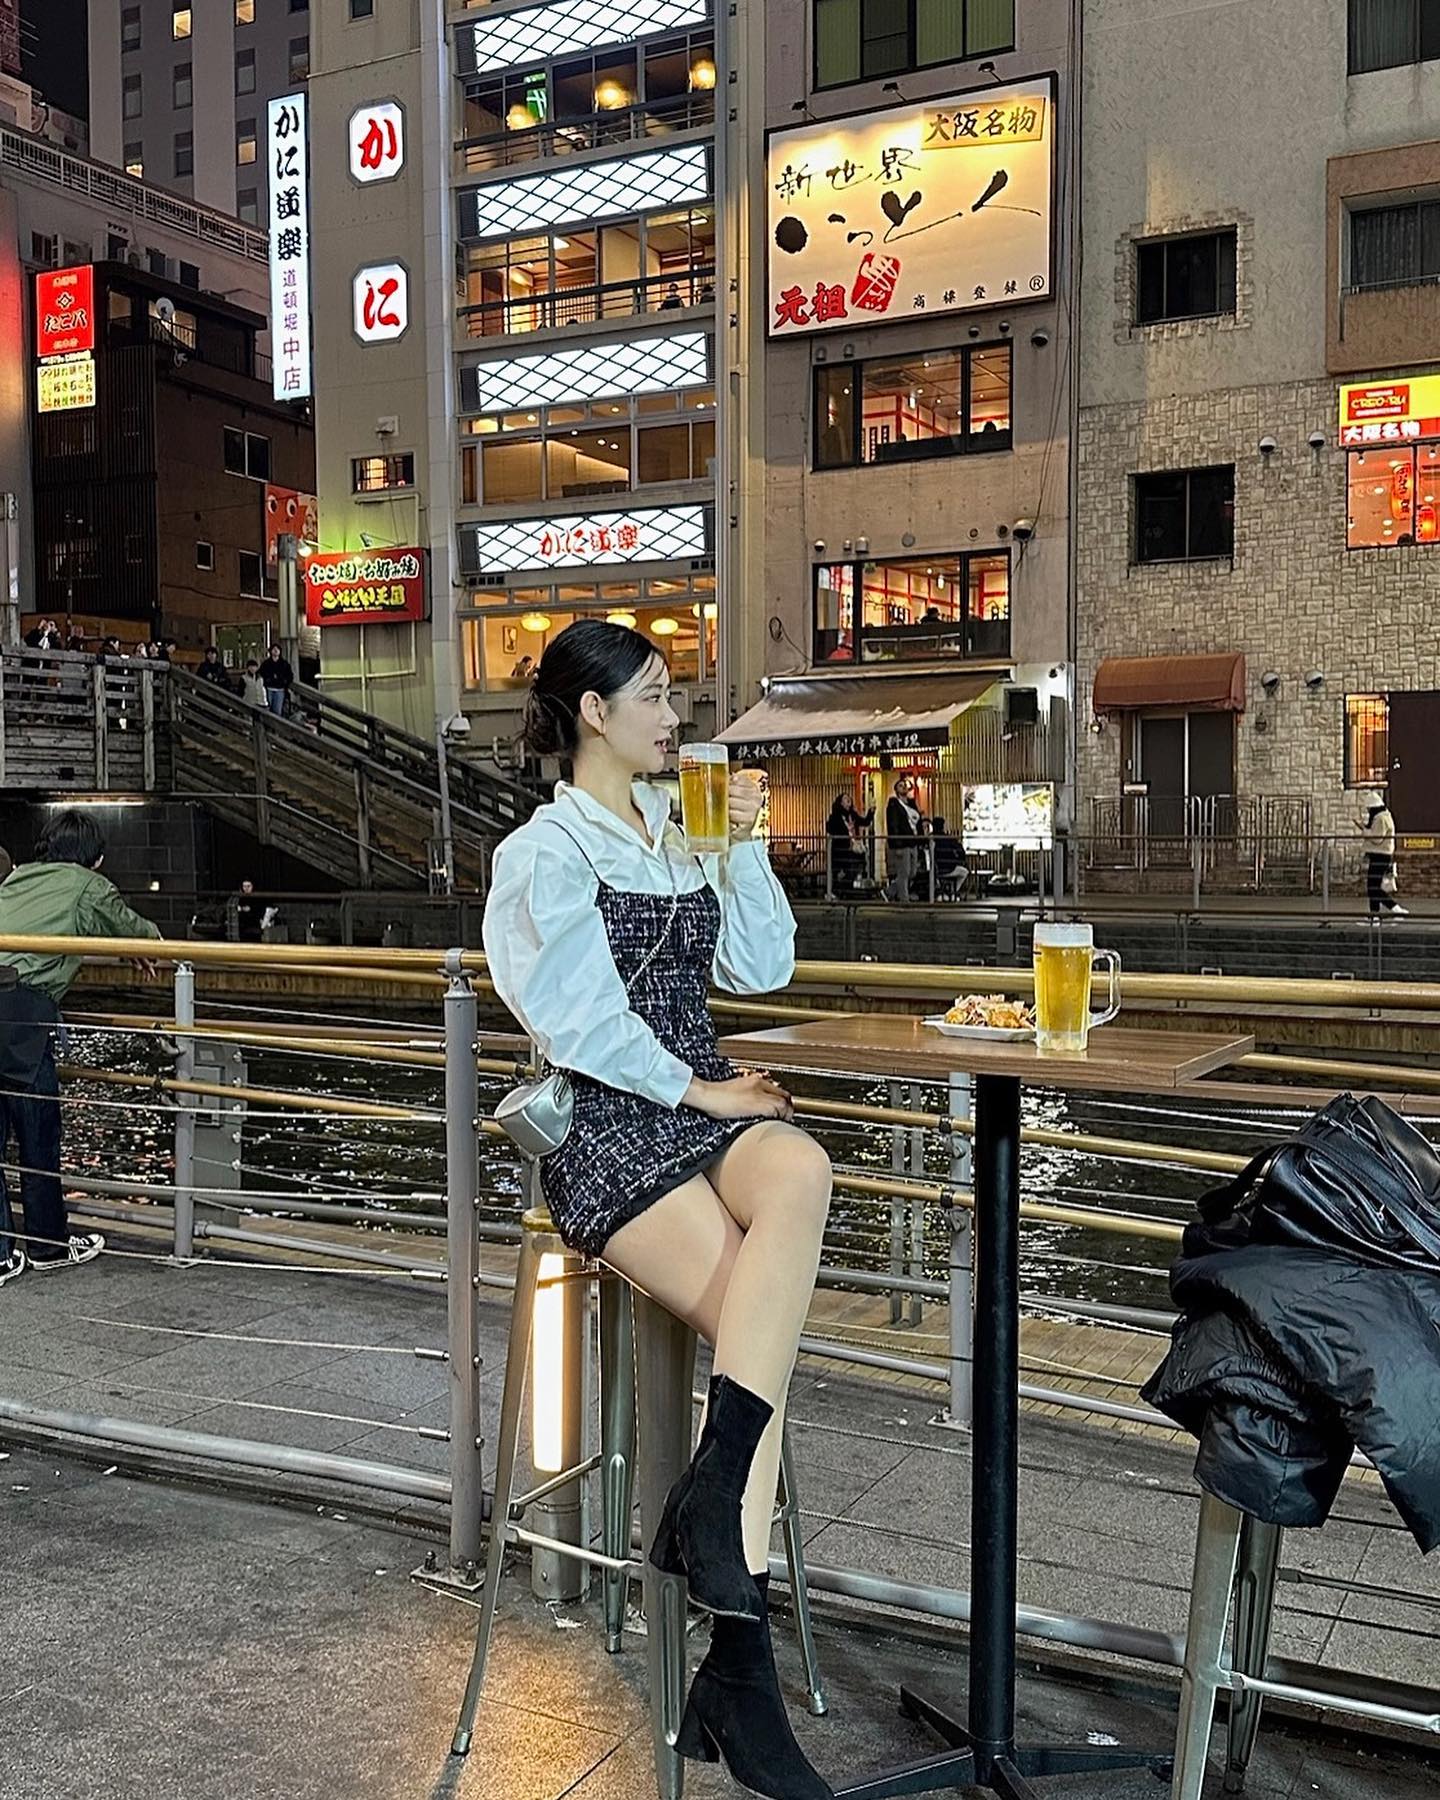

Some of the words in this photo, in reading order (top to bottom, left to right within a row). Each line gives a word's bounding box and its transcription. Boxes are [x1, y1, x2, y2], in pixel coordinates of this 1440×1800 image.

[357, 118, 397, 169] か
[926, 105, 1037, 143] 大阪名物
[774, 147, 921, 205] 新世界
[363, 279, 400, 330] に
[773, 282, 849, 330] 元祖
[912, 279, 1018, 309] 商標登録
[282, 268, 302, 391] 道頓堀中店
[737, 742, 787, 760] 鉄板焼
[799, 733, 921, 756] 鉄板創作串料理
